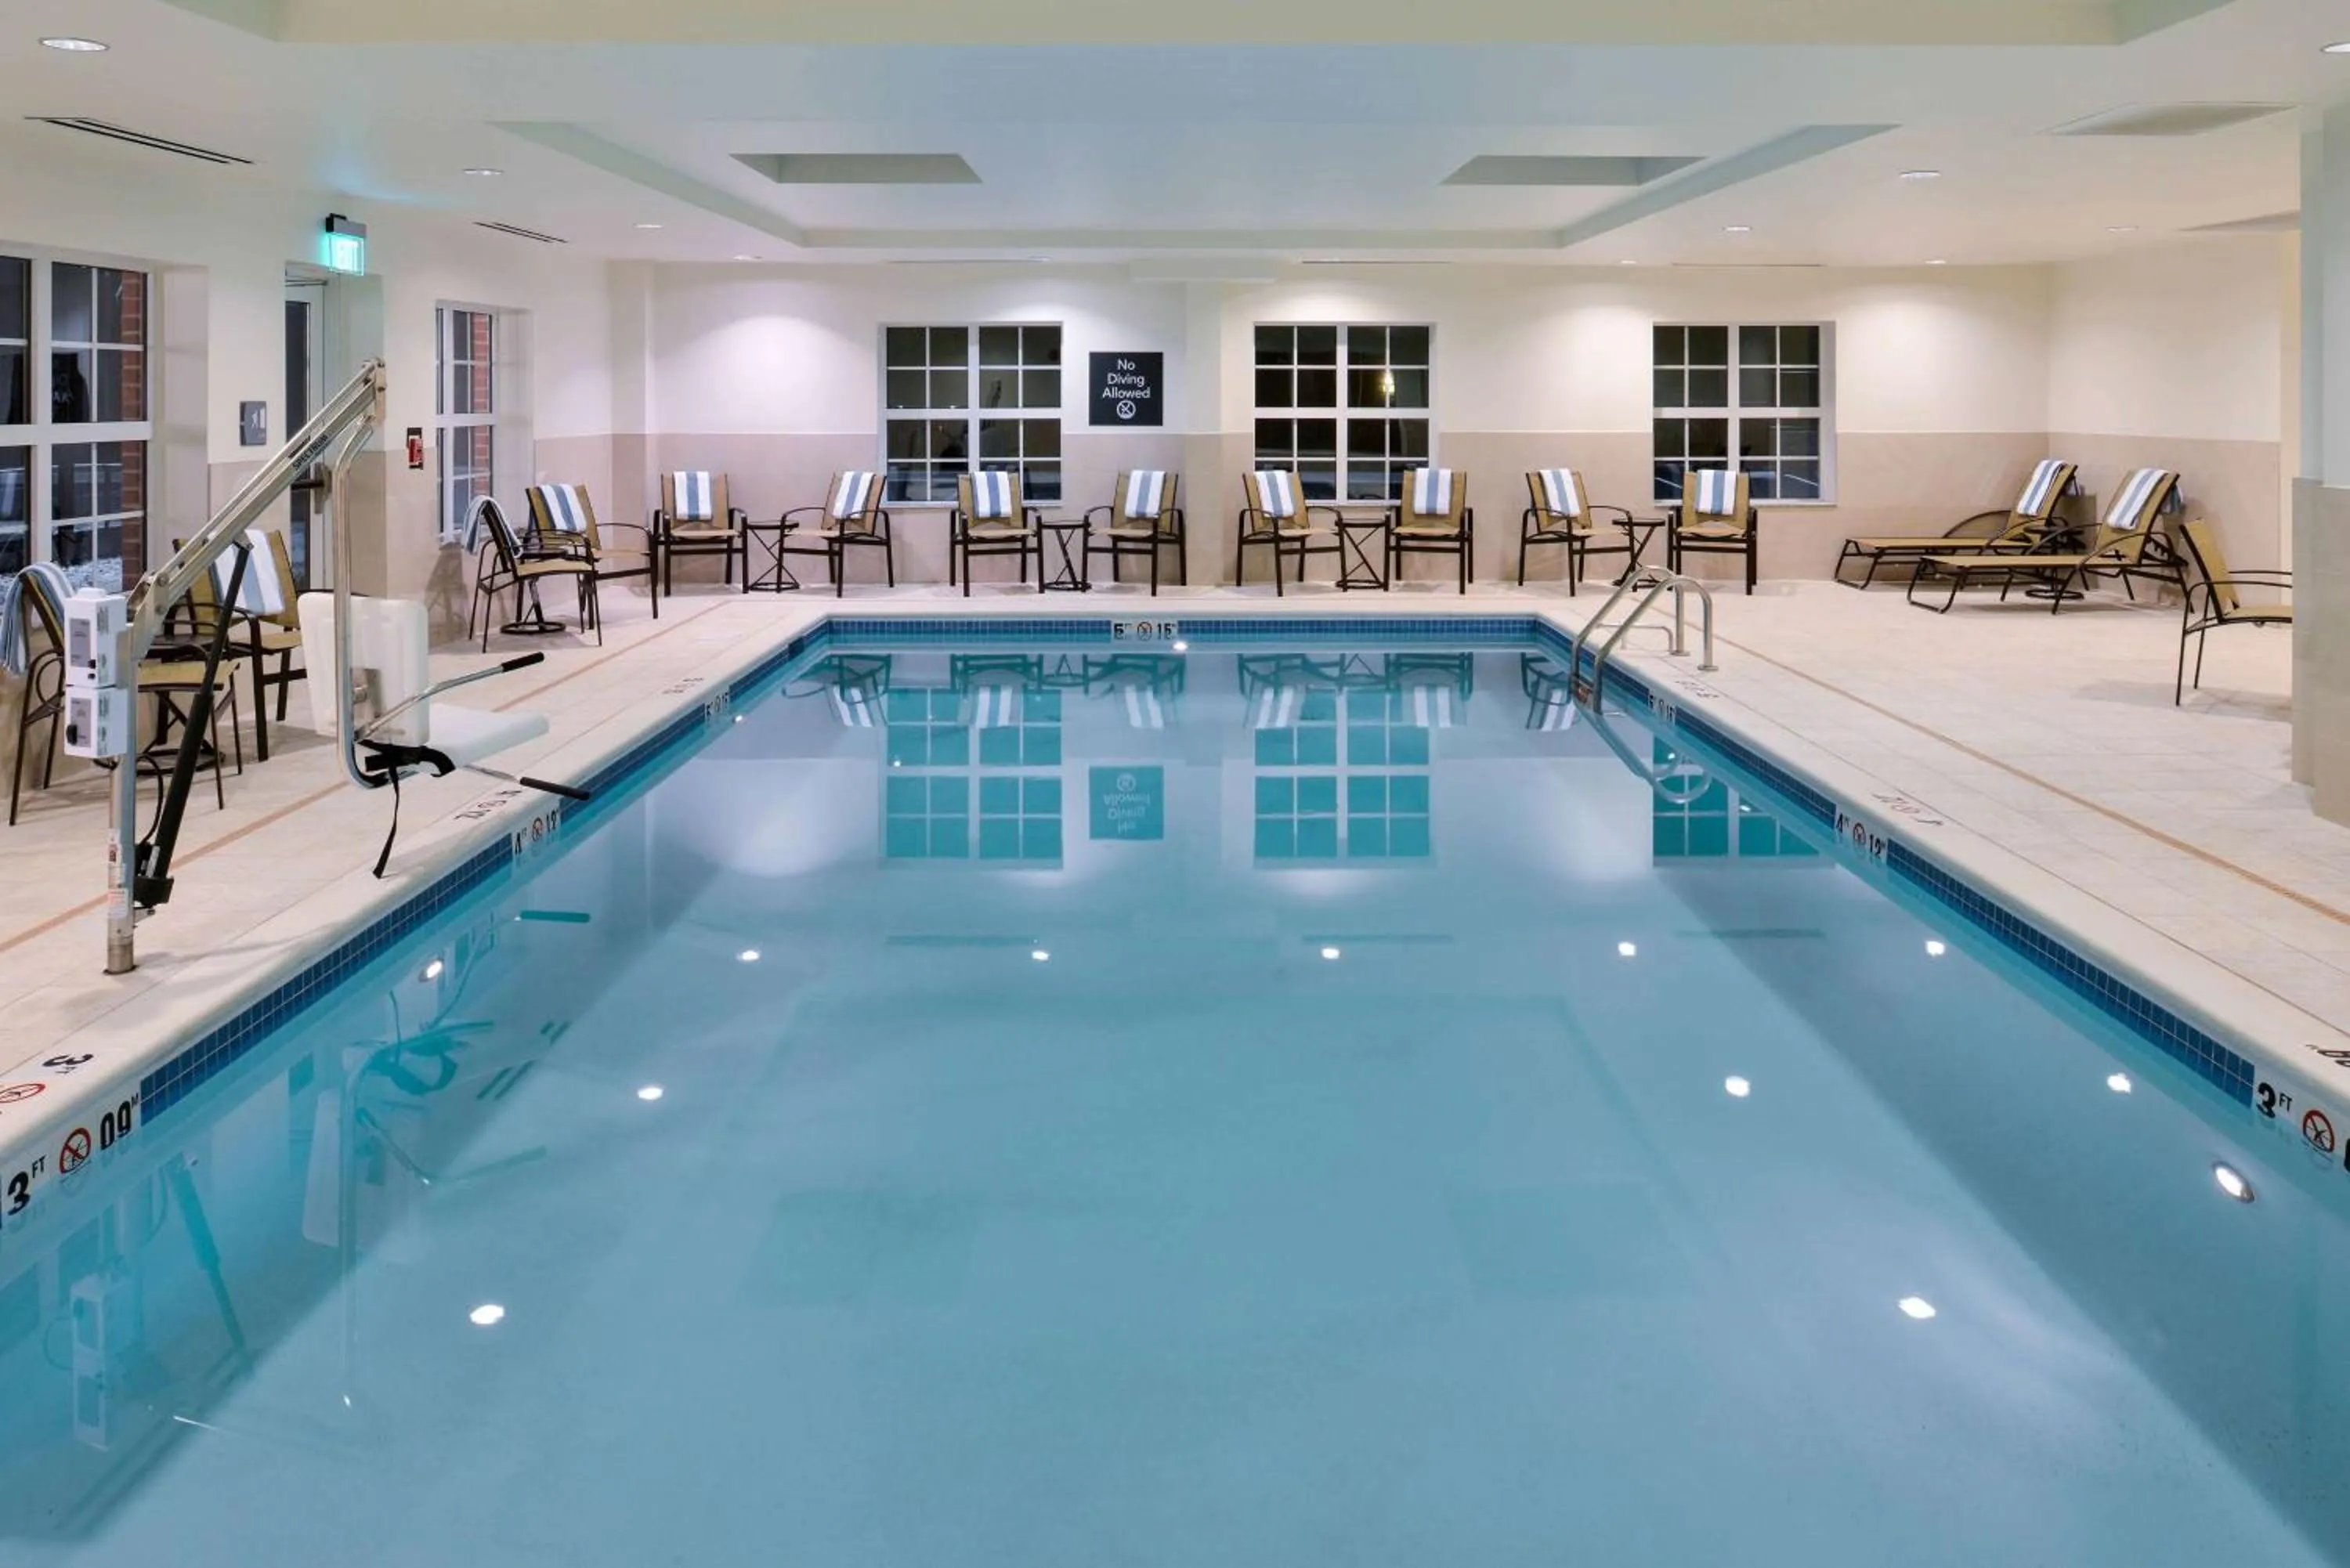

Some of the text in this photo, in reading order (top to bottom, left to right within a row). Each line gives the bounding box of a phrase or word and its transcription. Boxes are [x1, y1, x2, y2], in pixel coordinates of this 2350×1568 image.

[1117, 358, 1136, 370] No
[1107, 372, 1144, 388] Diving
[1102, 386, 1151, 399] Allowed
[291, 434, 328, 470] SPECTRUM
[8, 1172, 30, 1216] 3
